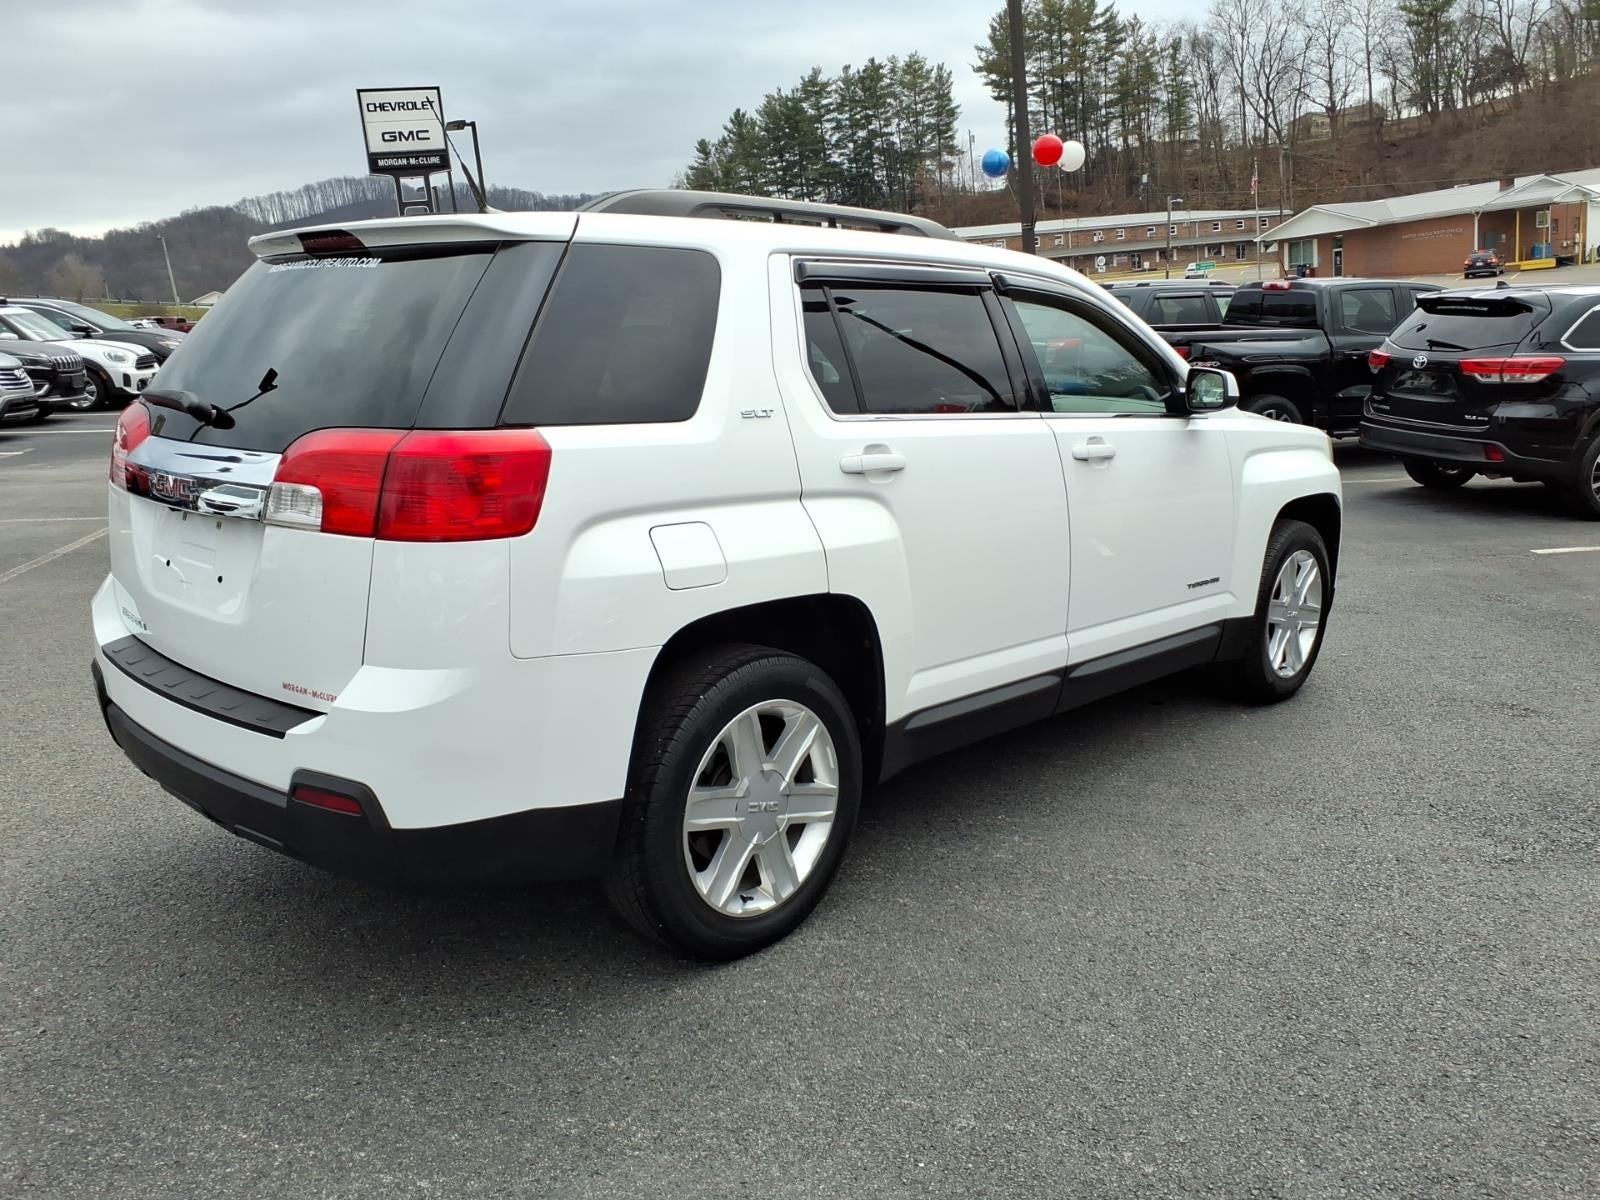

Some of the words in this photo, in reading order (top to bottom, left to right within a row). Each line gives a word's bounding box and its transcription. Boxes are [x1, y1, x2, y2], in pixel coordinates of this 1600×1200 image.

[381, 129, 431, 142] GMC
[740, 409, 774, 419] SLT
[155, 473, 193, 499] GMC
